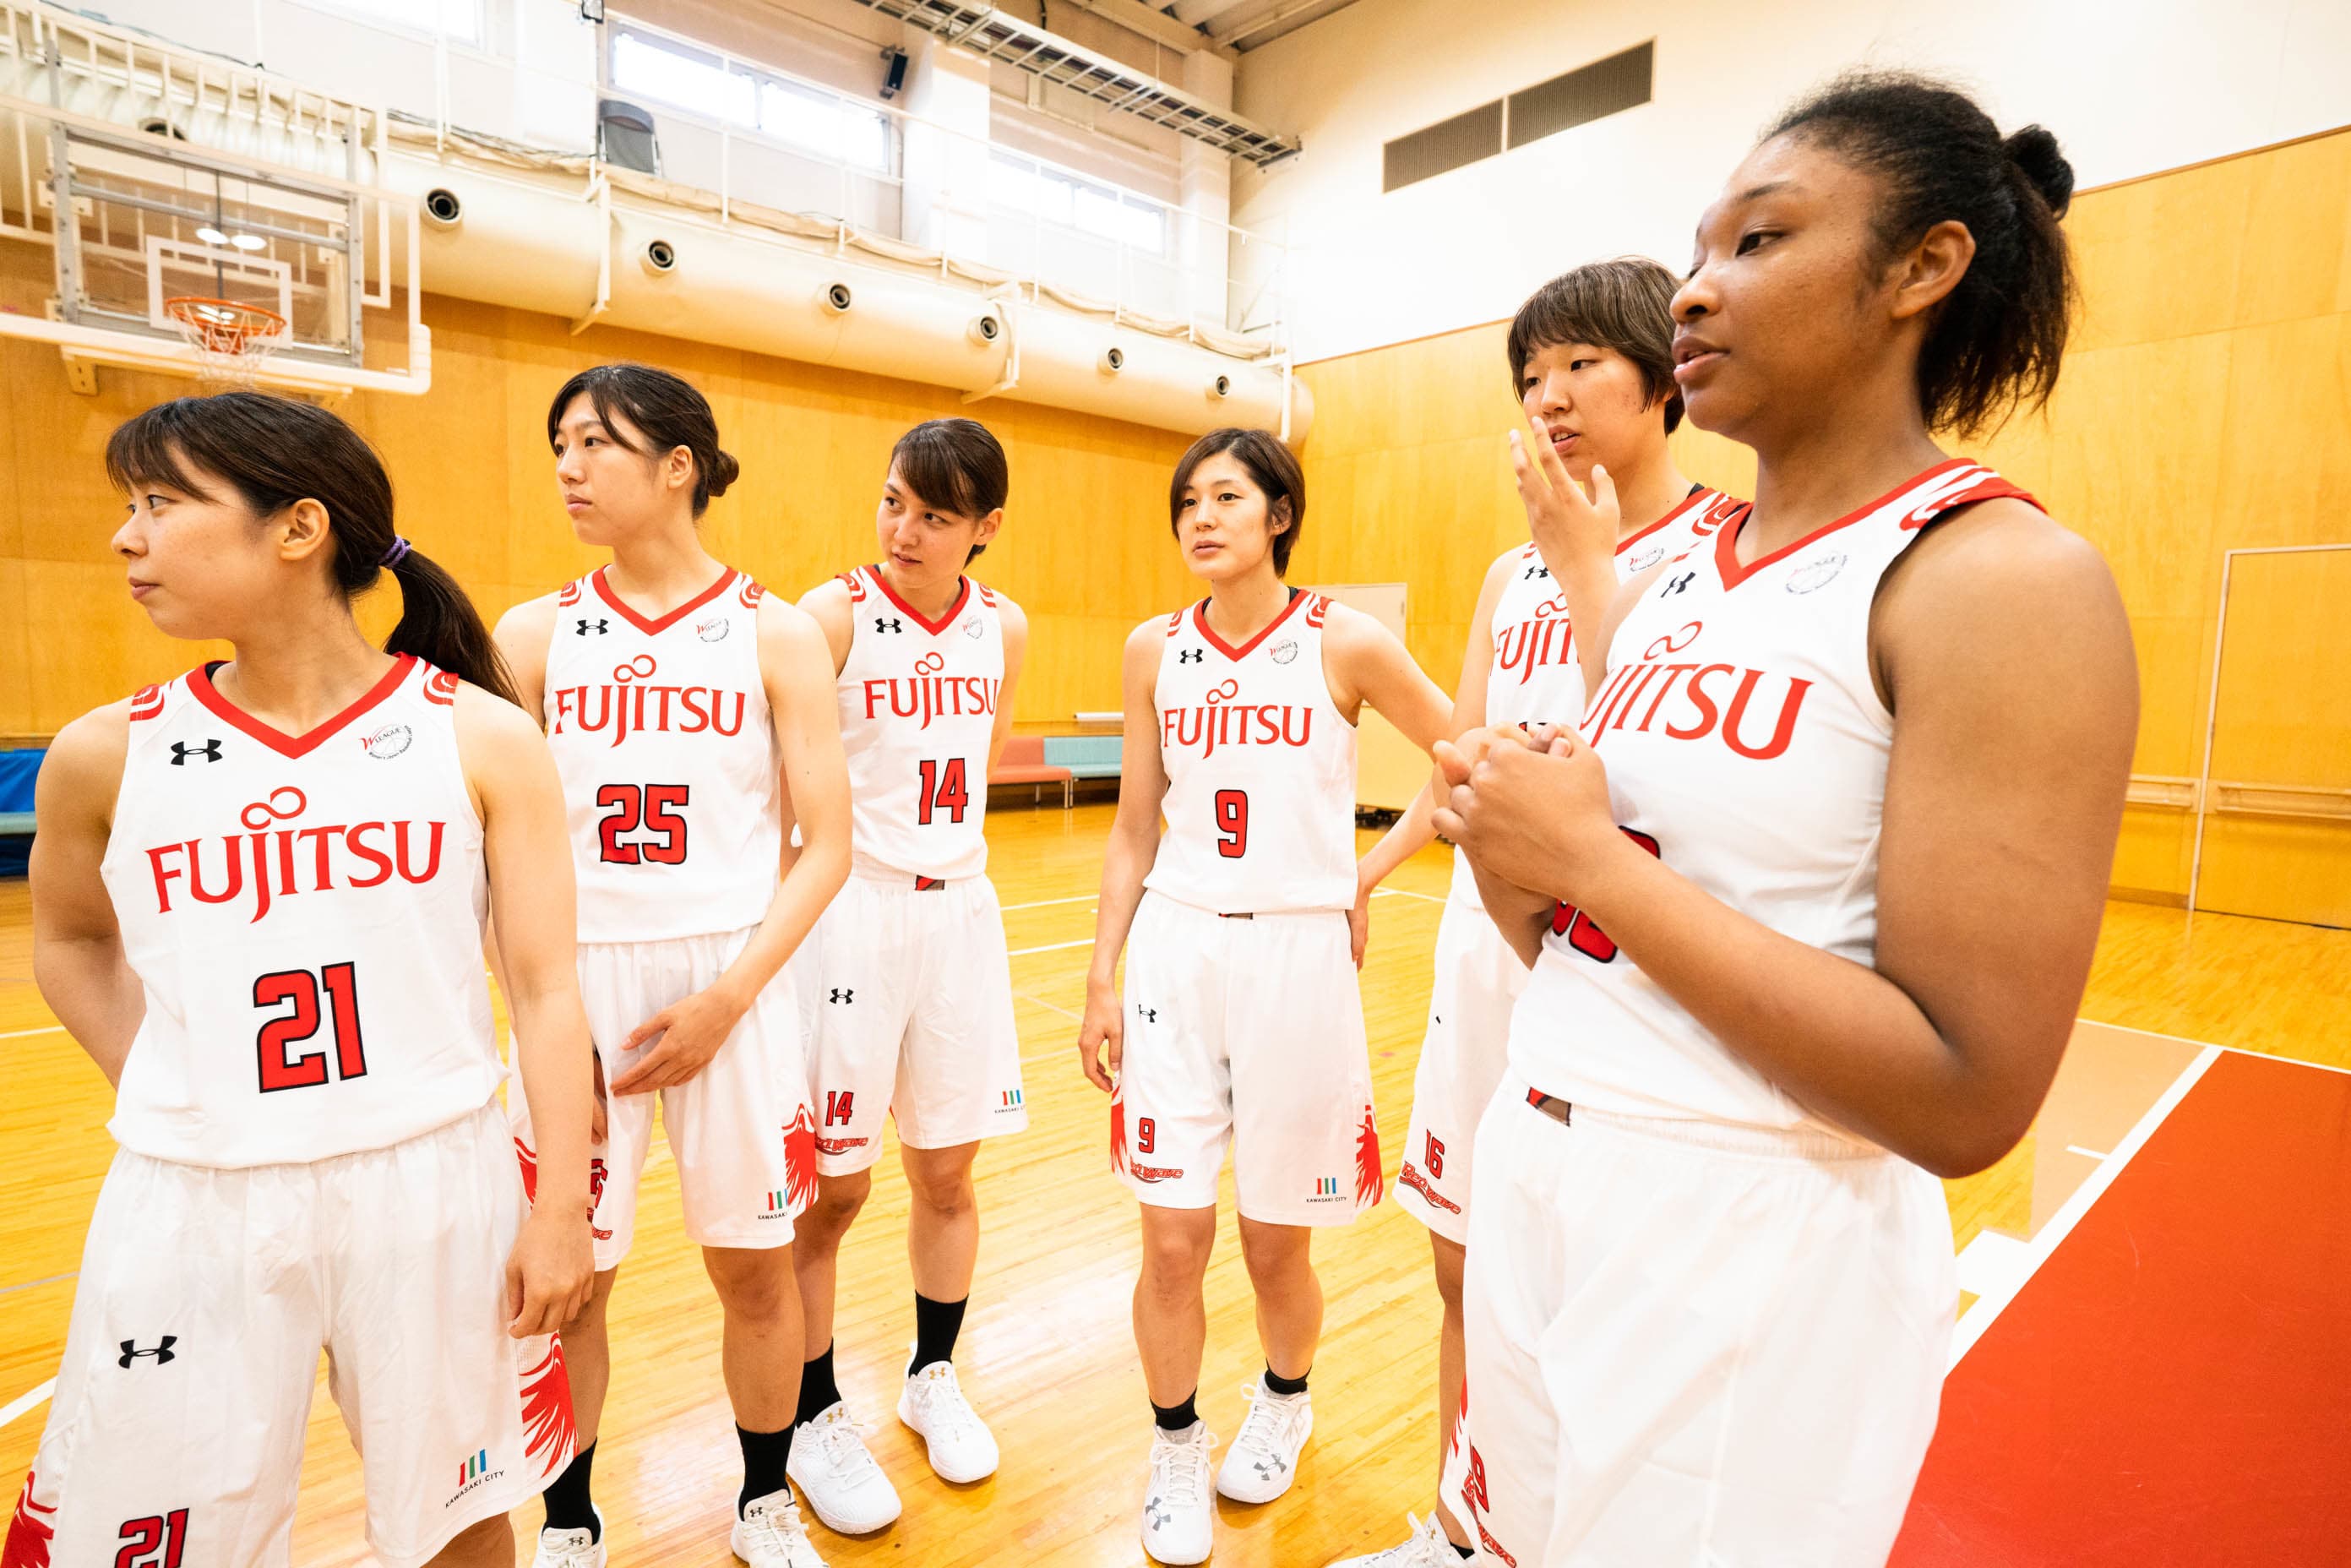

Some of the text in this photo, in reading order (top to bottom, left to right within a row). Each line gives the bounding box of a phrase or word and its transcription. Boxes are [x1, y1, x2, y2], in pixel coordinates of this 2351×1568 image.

[554, 685, 746, 748] FUJITSU
[863, 677, 999, 730] FUJITSU
[1163, 705, 1313, 760] FUJITSU
[1579, 663, 1815, 760] UJITSU
[918, 758, 968, 825] 14
[596, 783, 689, 865] 25
[1215, 789, 1248, 858] 9
[144, 820, 447, 923] FUJITSU
[253, 961, 367, 1093] 21
[825, 1091, 854, 1126] 14
[1139, 1117, 1155, 1154] 9
[1424, 1128, 1445, 1179] 16
[445, 1469, 504, 1509] KAWASAKI CITY
[114, 1507, 190, 1568] 21
